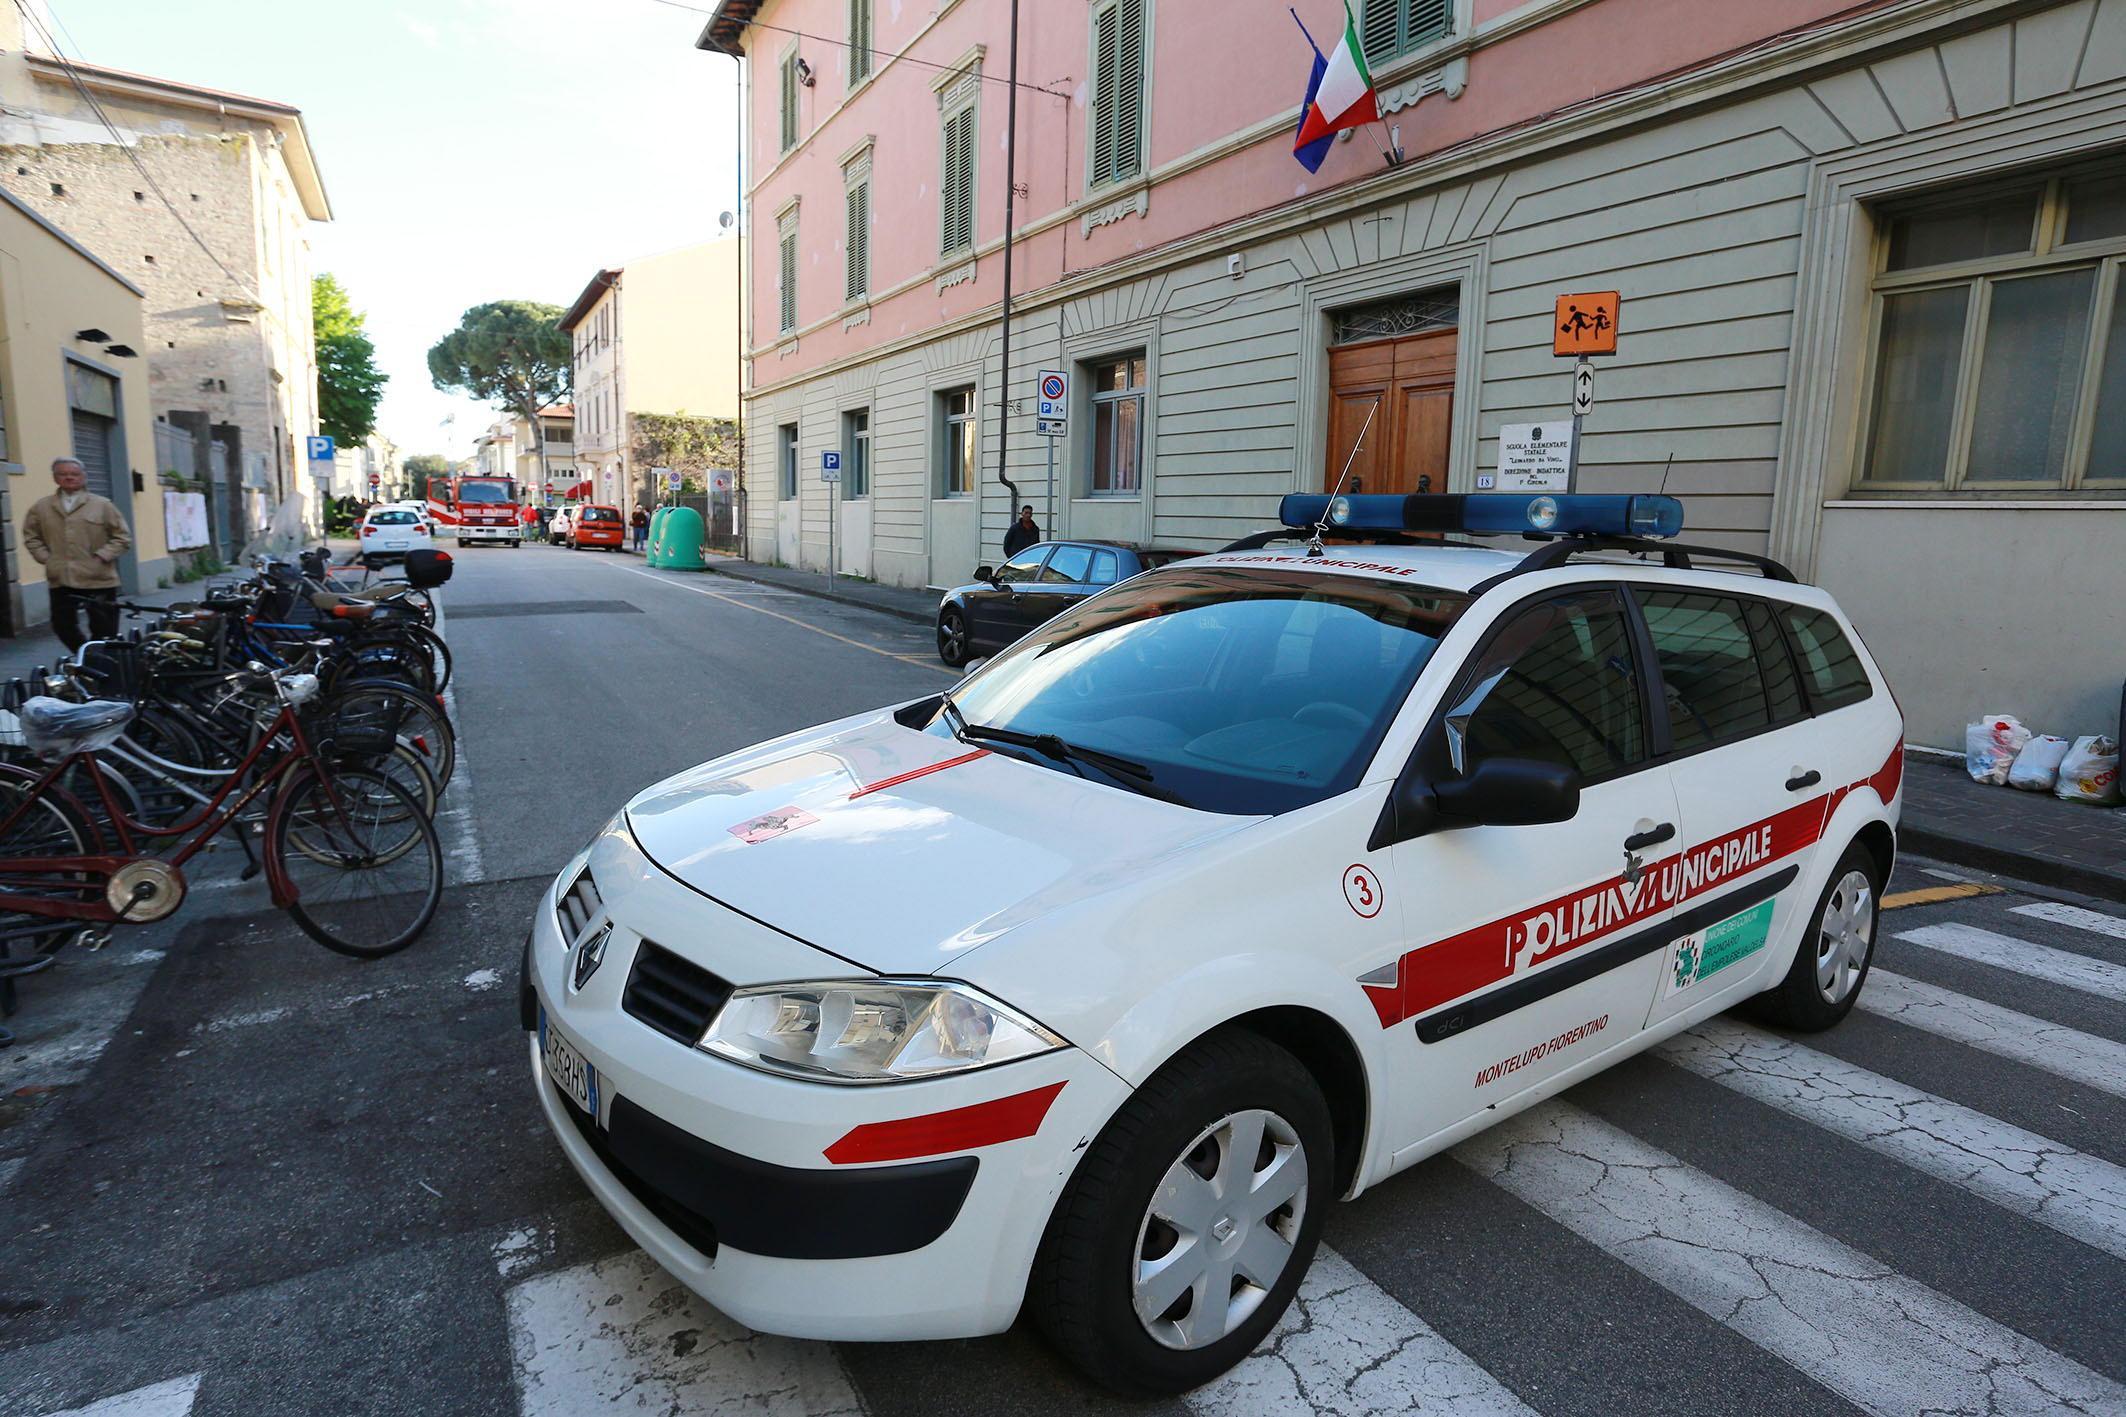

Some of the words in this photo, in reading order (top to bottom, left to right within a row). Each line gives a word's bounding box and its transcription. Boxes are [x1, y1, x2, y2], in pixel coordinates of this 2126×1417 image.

[311, 438, 329, 458] P
[827, 455, 836, 467] P
[1481, 477, 1490, 486] 18
[1354, 875, 1373, 906] 3
[1474, 1042, 1547, 1089] MONTELUPO
[1546, 1013, 1609, 1056] FIORENTINO
